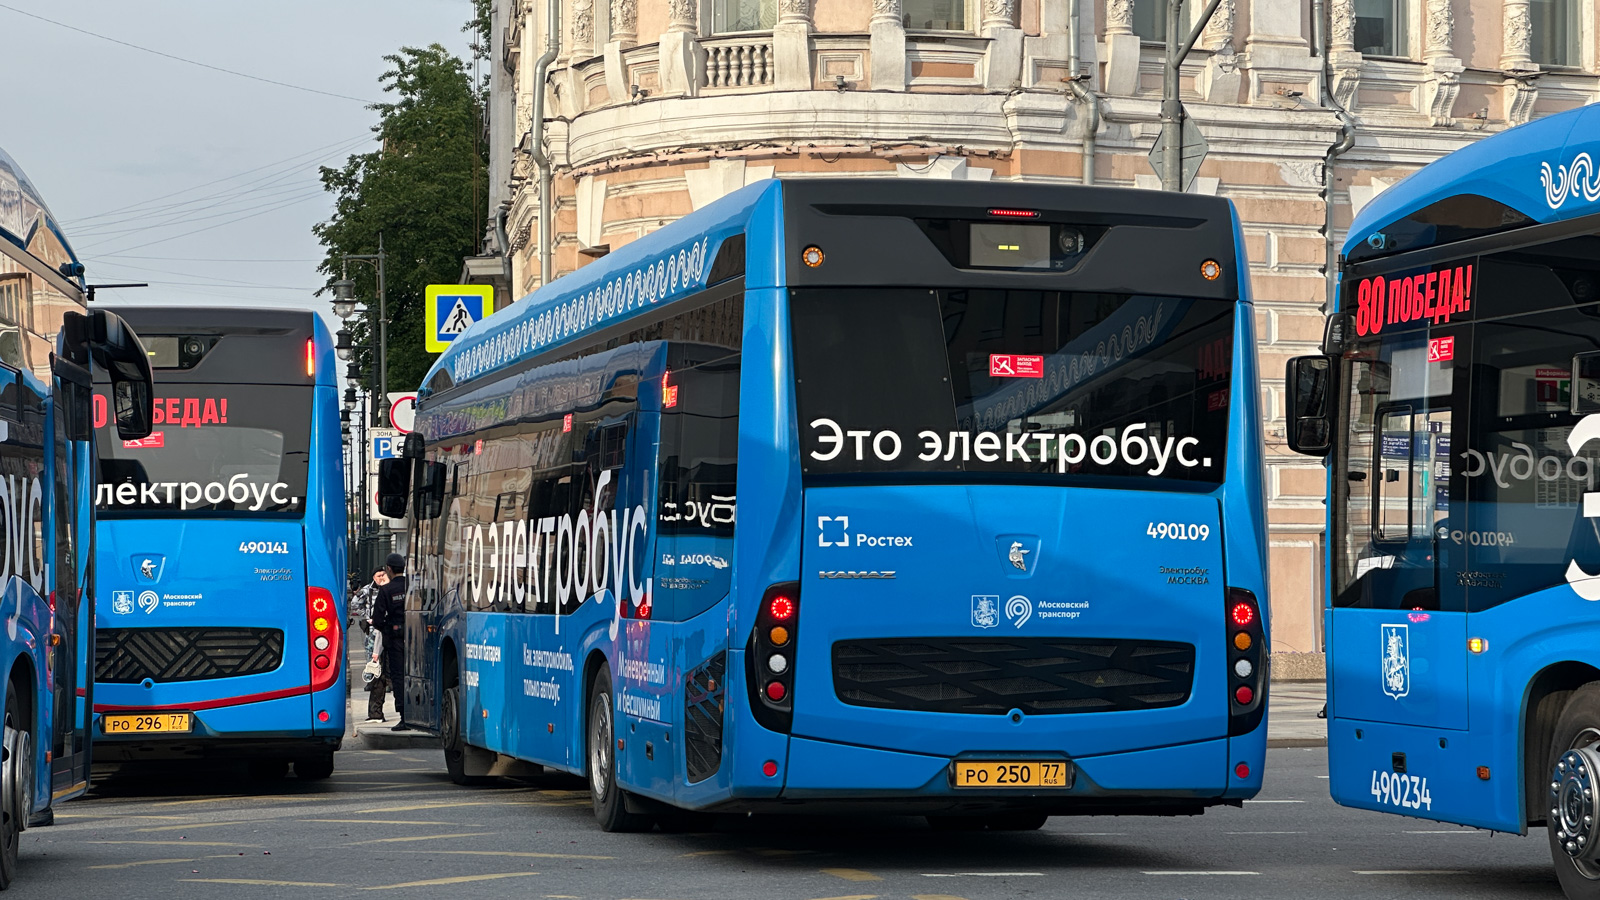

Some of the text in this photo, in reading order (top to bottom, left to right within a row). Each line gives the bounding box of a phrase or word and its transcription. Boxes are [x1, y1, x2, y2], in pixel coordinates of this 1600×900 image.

[1356, 265, 1472, 336] 80 ПОБЕДА!
[93, 394, 228, 428] 0 БЕДА!
[380, 440, 391, 457] P
[810, 417, 1212, 476] Это электробус.
[95, 473, 298, 511] лектробус.
[856, 533, 914, 547] Ростех
[1146, 522, 1210, 541] 490109
[238, 541, 289, 554] 490141
[819, 570, 897, 579] KAMAZ
[1159, 566, 1209, 576] Электробус
[1167, 576, 1209, 585] МОСКВА
[1038, 600, 1090, 609] Московский
[1038, 611, 1081, 619] транспорт
[523, 643, 533, 667] Как
[617, 651, 665, 687] Маневренный
[523, 679, 540, 698] только
[617, 686, 661, 723] и бесшумный
[136, 717, 162, 730] 296
[170, 715, 184, 725] 77
[996, 765, 1031, 783] 250
[1042, 764, 1060, 778] 77
[1371, 770, 1432, 811] 490234
